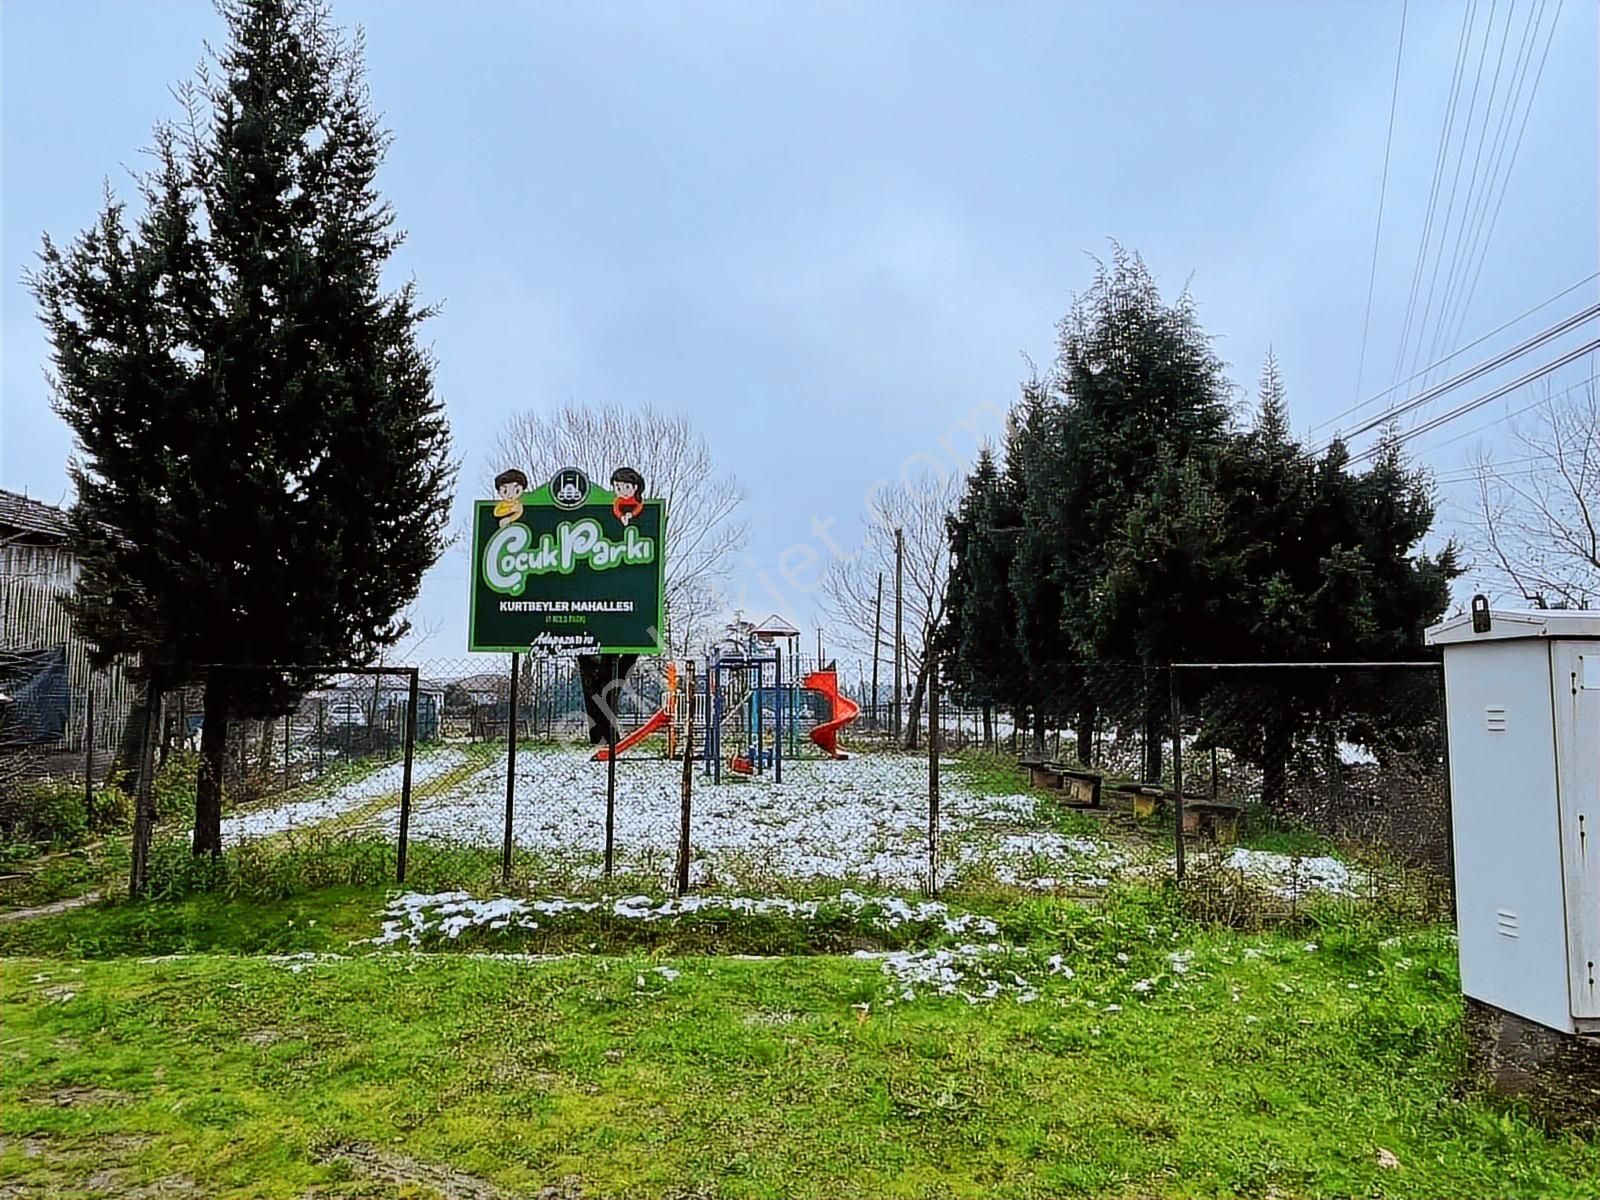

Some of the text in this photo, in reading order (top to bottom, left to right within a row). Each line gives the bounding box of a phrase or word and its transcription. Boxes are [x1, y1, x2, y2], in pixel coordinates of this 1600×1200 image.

[485, 520, 651, 592] Çocuk Parkı
[499, 601, 569, 612] KURTBEYLER
